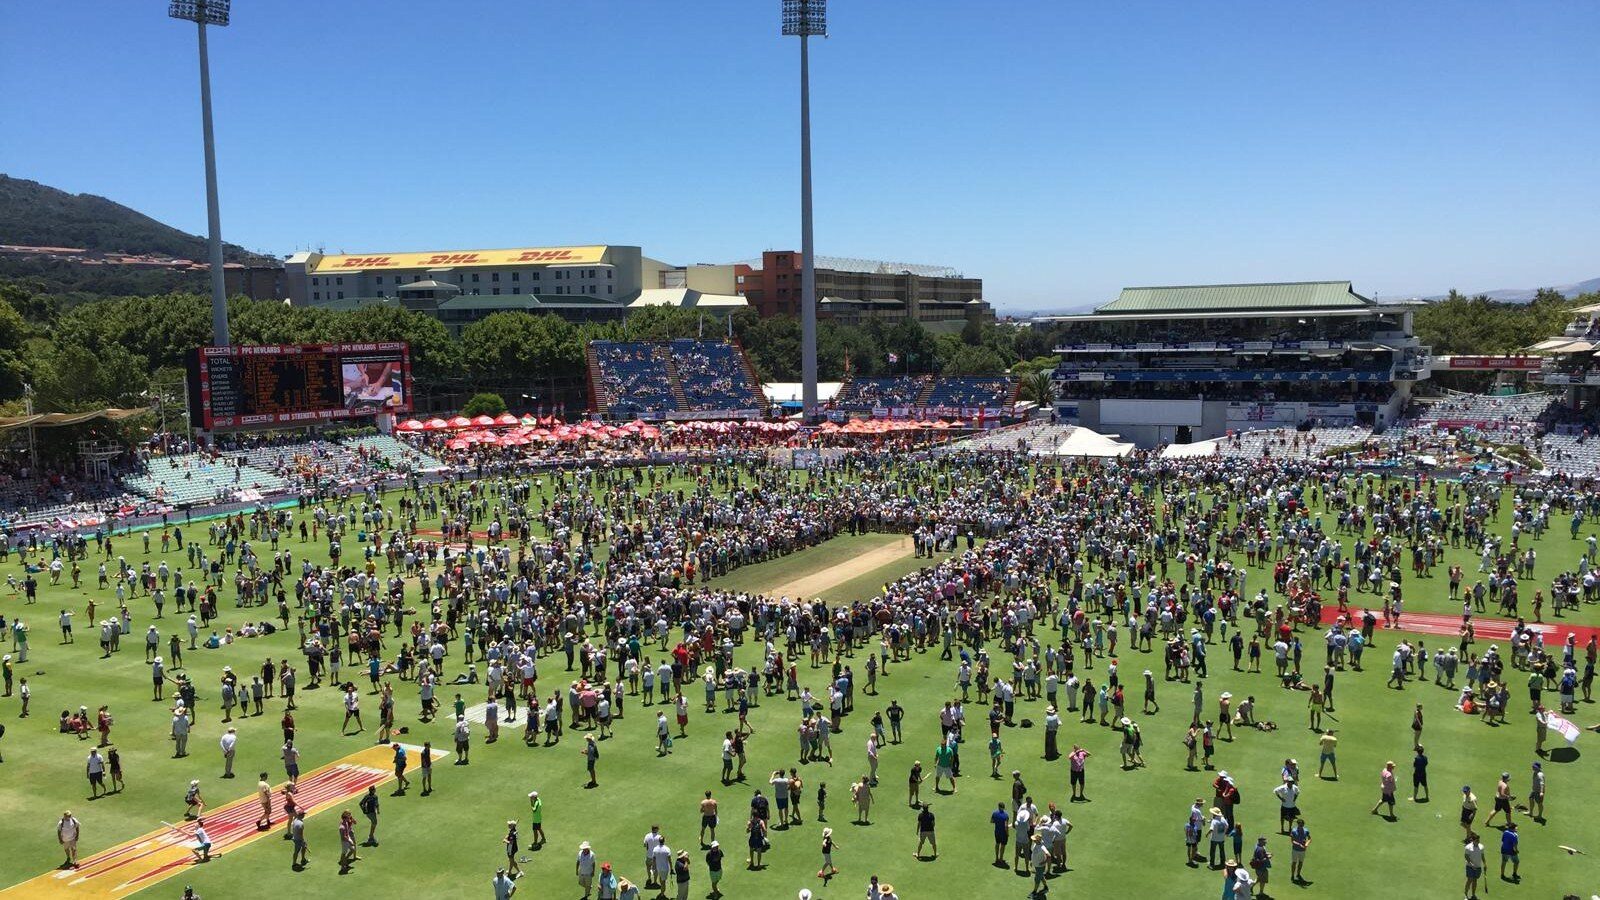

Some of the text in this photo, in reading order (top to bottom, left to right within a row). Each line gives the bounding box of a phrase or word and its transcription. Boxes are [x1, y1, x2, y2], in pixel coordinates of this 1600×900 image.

[342, 256, 392, 268] DHL
[427, 253, 480, 265] DHL
[518, 250, 572, 262] DHL
